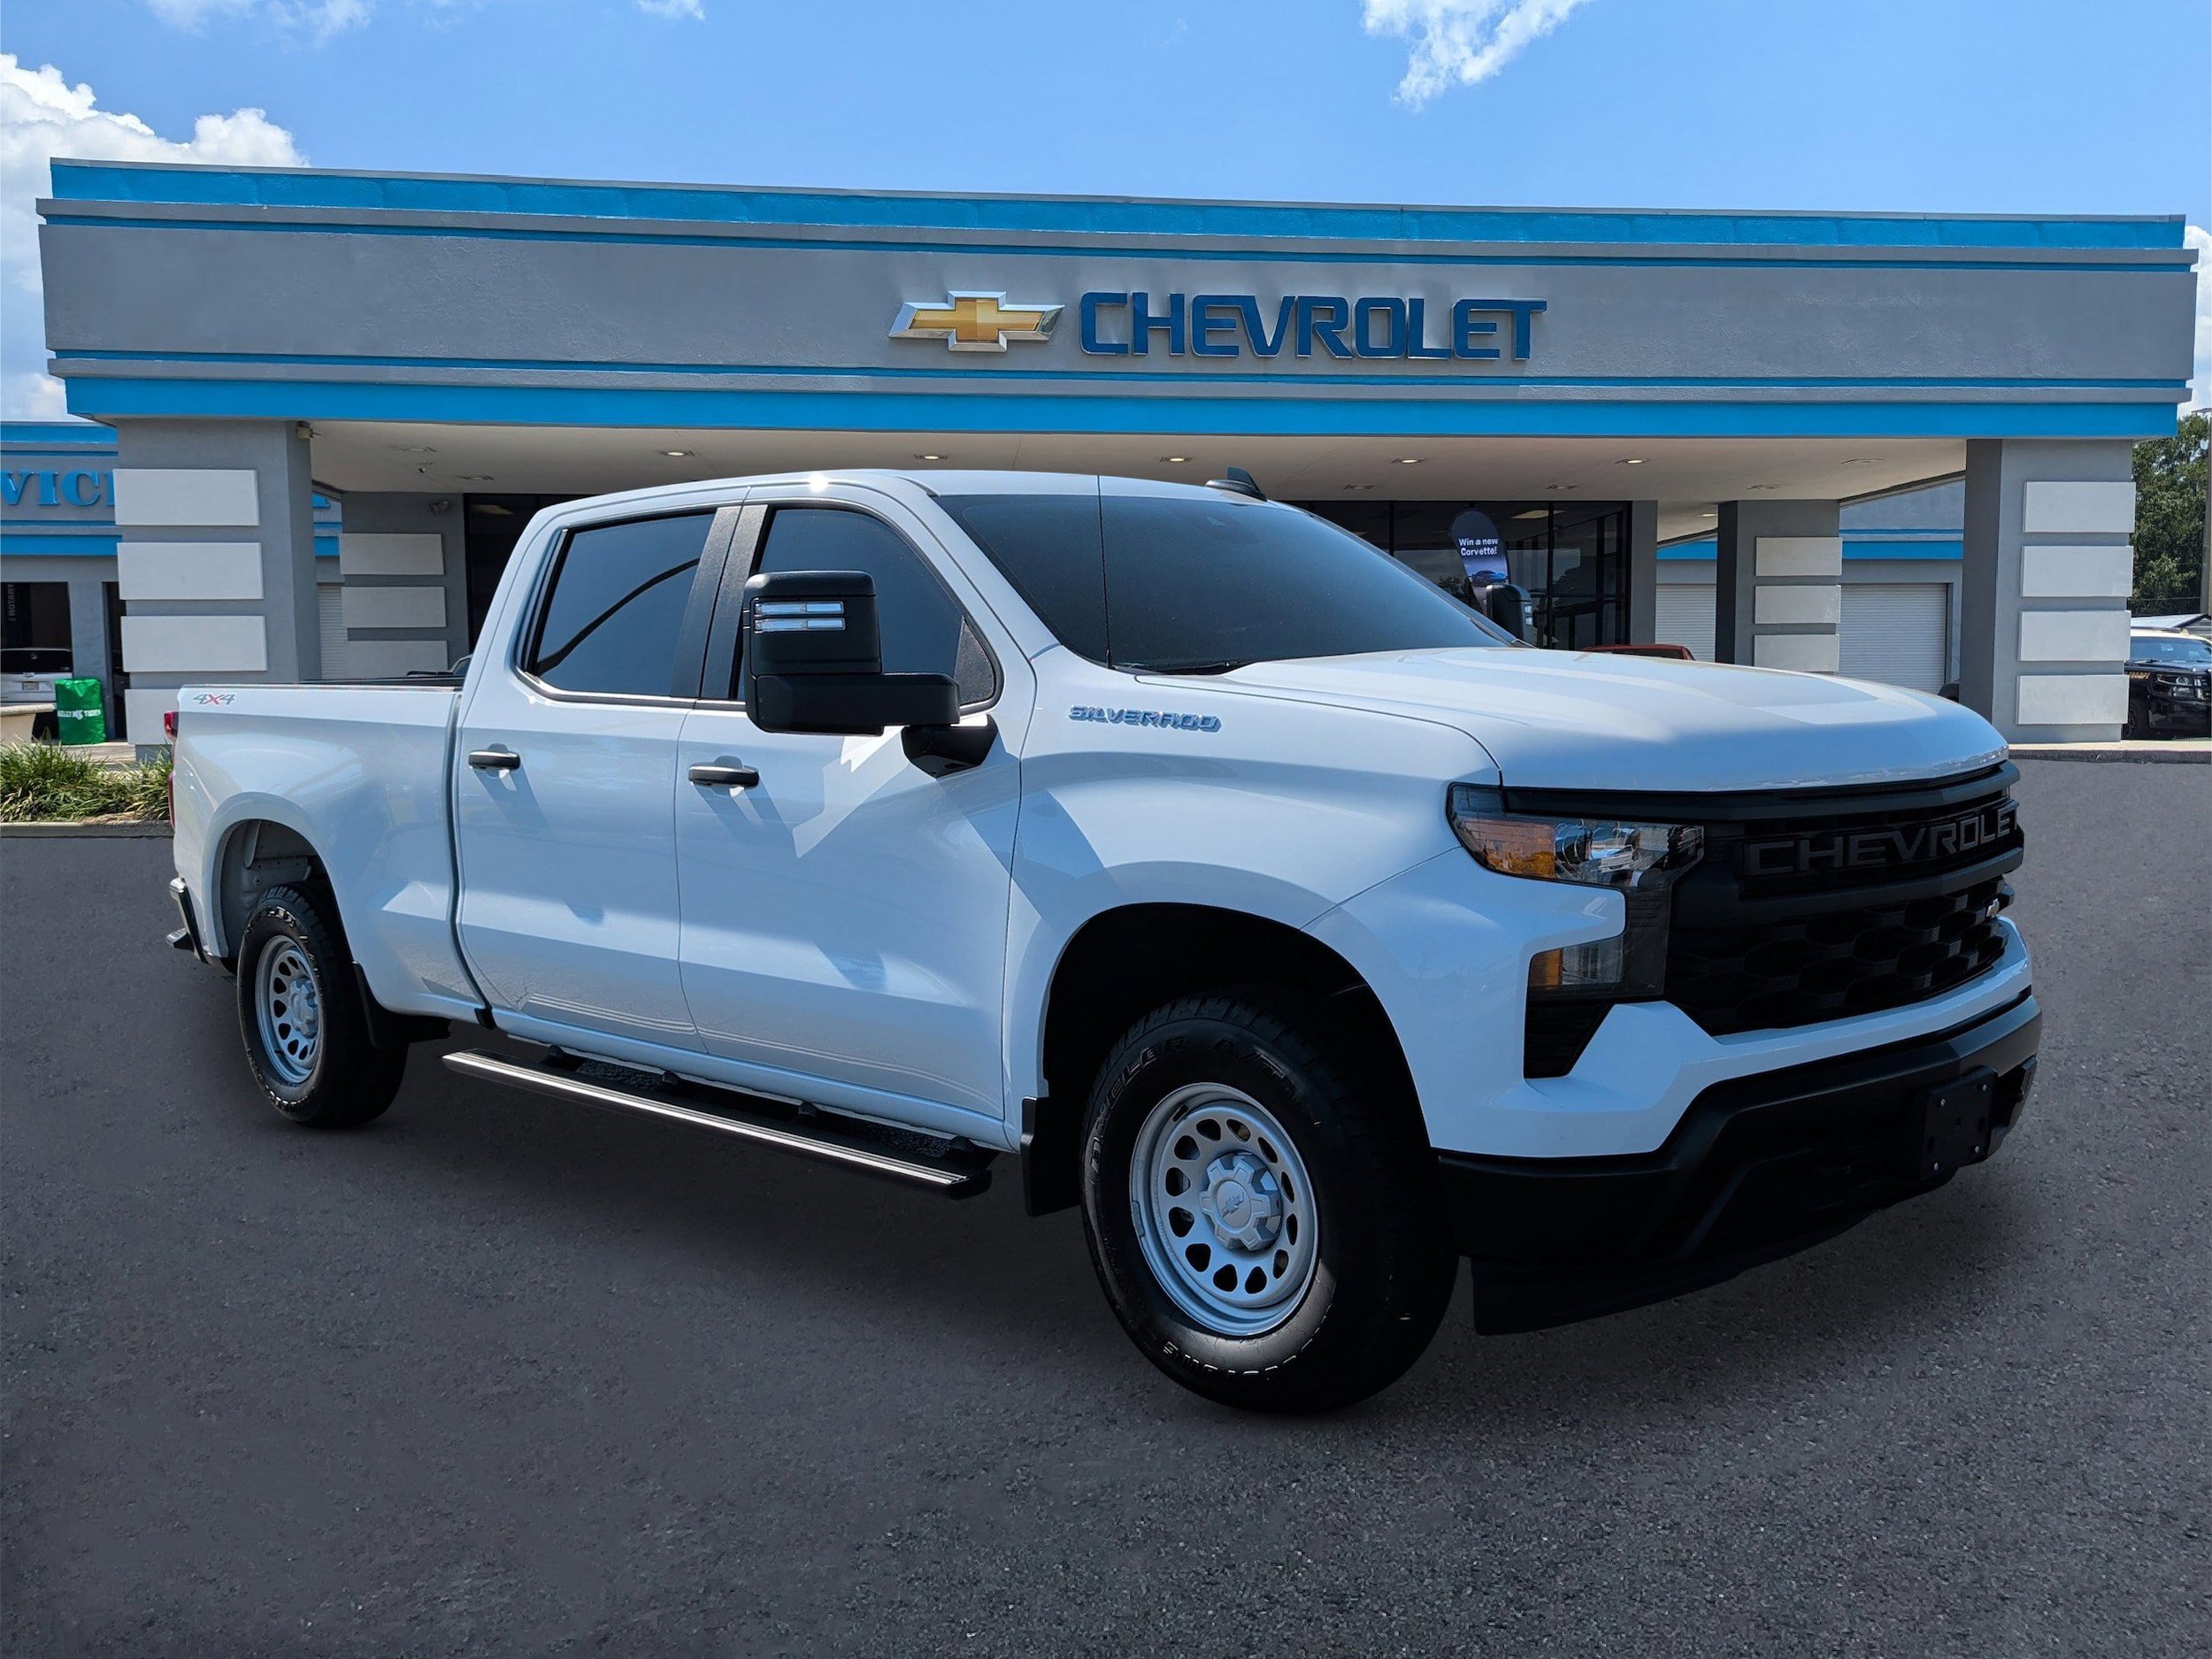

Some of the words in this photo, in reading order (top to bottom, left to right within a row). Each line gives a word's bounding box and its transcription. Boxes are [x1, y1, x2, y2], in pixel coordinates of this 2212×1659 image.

[1080, 291, 1548, 359] CHEVROLET
[1458, 537, 1474, 547] Win
[1460, 547, 1498, 557] Corvette!
[1069, 705, 1222, 733] SILVERADO
